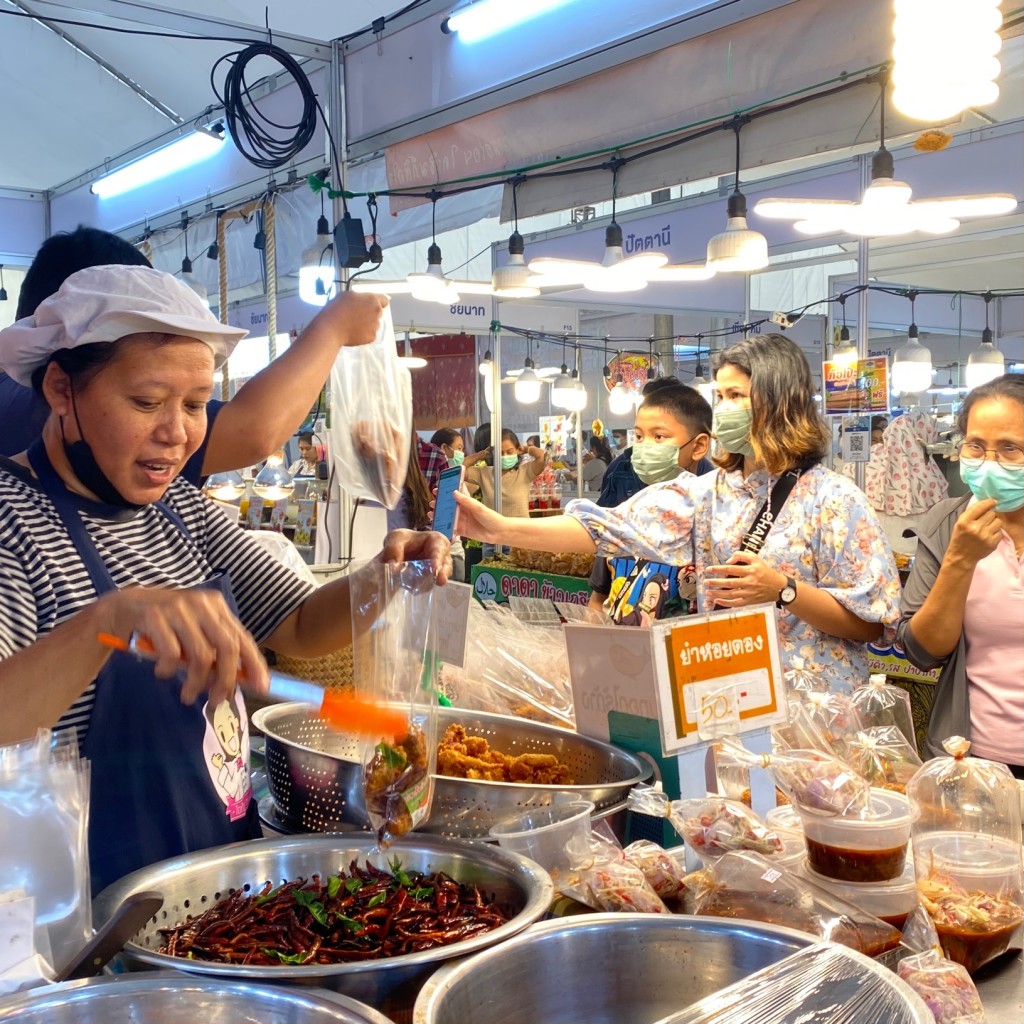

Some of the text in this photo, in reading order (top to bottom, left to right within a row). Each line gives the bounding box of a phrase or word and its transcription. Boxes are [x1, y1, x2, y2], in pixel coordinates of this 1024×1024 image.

[625, 224, 671, 253] ปัตตานี
[450, 303, 486, 316] ชัยนาท
[501, 574, 539, 598] ดาดา
[679, 634, 764, 666] ยำหอยดอง
